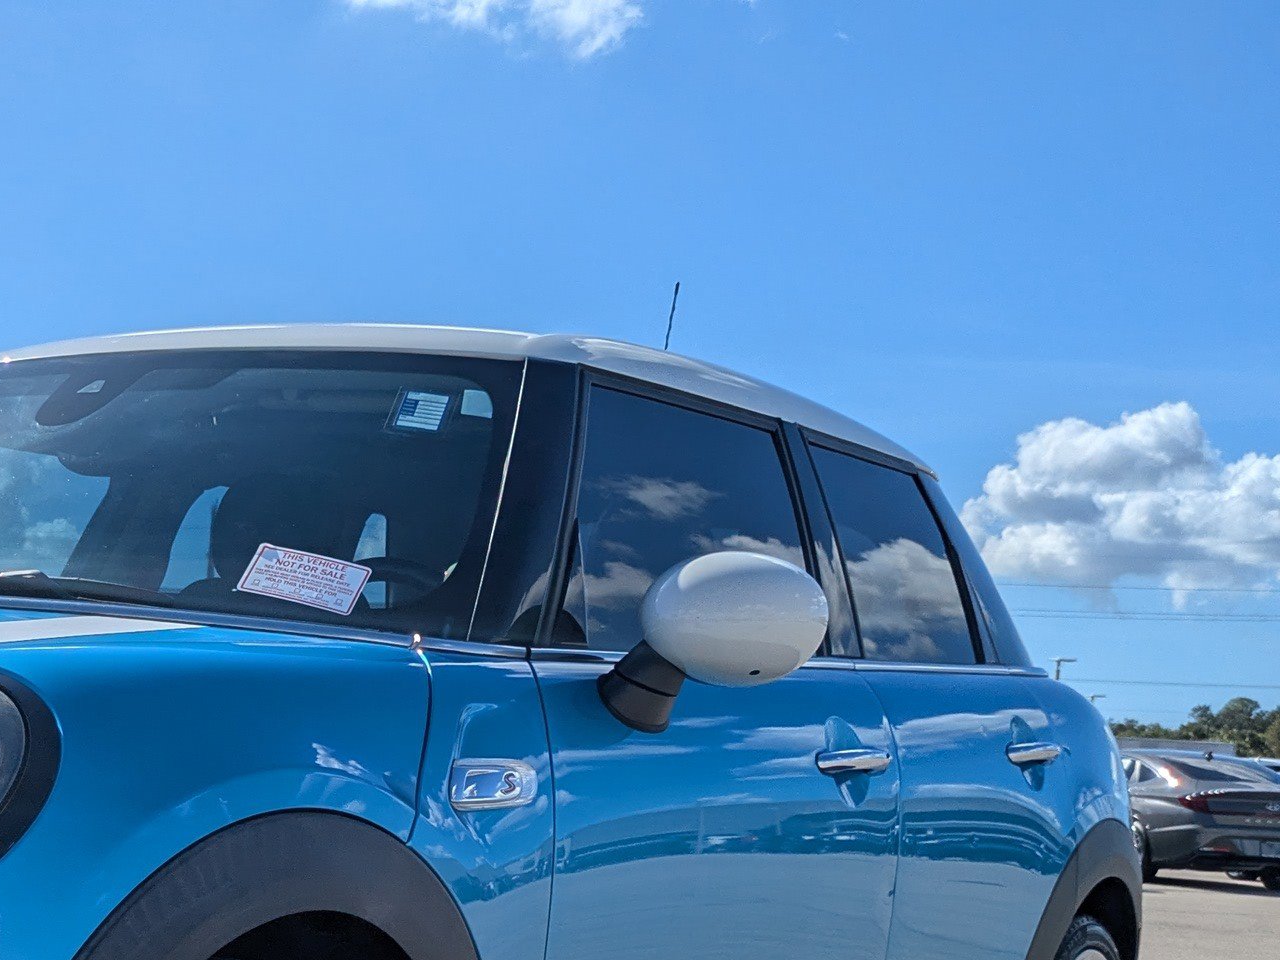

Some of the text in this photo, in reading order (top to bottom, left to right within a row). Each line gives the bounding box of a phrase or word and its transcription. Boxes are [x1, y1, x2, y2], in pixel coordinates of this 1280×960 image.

[275, 558, 347, 580] NOT FOR SALE
[282, 553, 348, 572] THIS VEHICLE
[275, 566, 298, 574] DEALER
[311, 573, 336, 583] RELEASE
[264, 576, 283, 584] HOLD
[298, 584, 323, 594] VEHICLE
[500, 772, 517, 796] S
